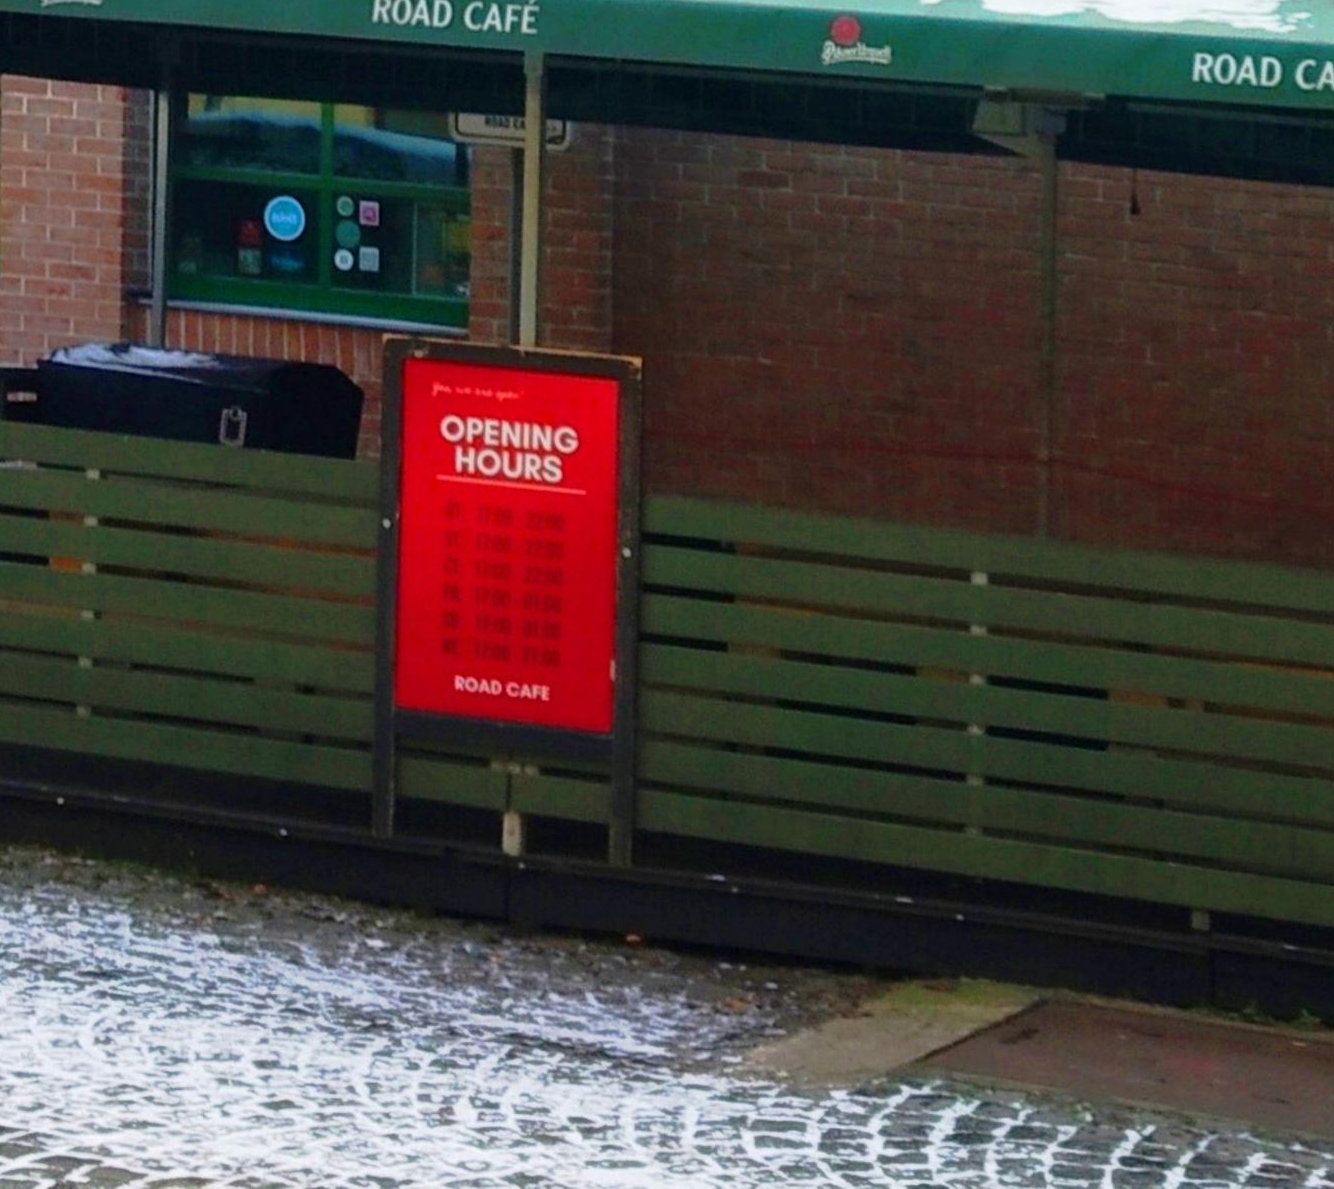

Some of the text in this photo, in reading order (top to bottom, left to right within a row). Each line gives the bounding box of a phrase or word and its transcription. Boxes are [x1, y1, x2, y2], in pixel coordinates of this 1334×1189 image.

[1192, 52, 1283, 87] ROAD
[440, 414, 580, 454] OPENING
[455, 445, 563, 483] HOURS
[454, 675, 550, 701] ROAD CAFE
